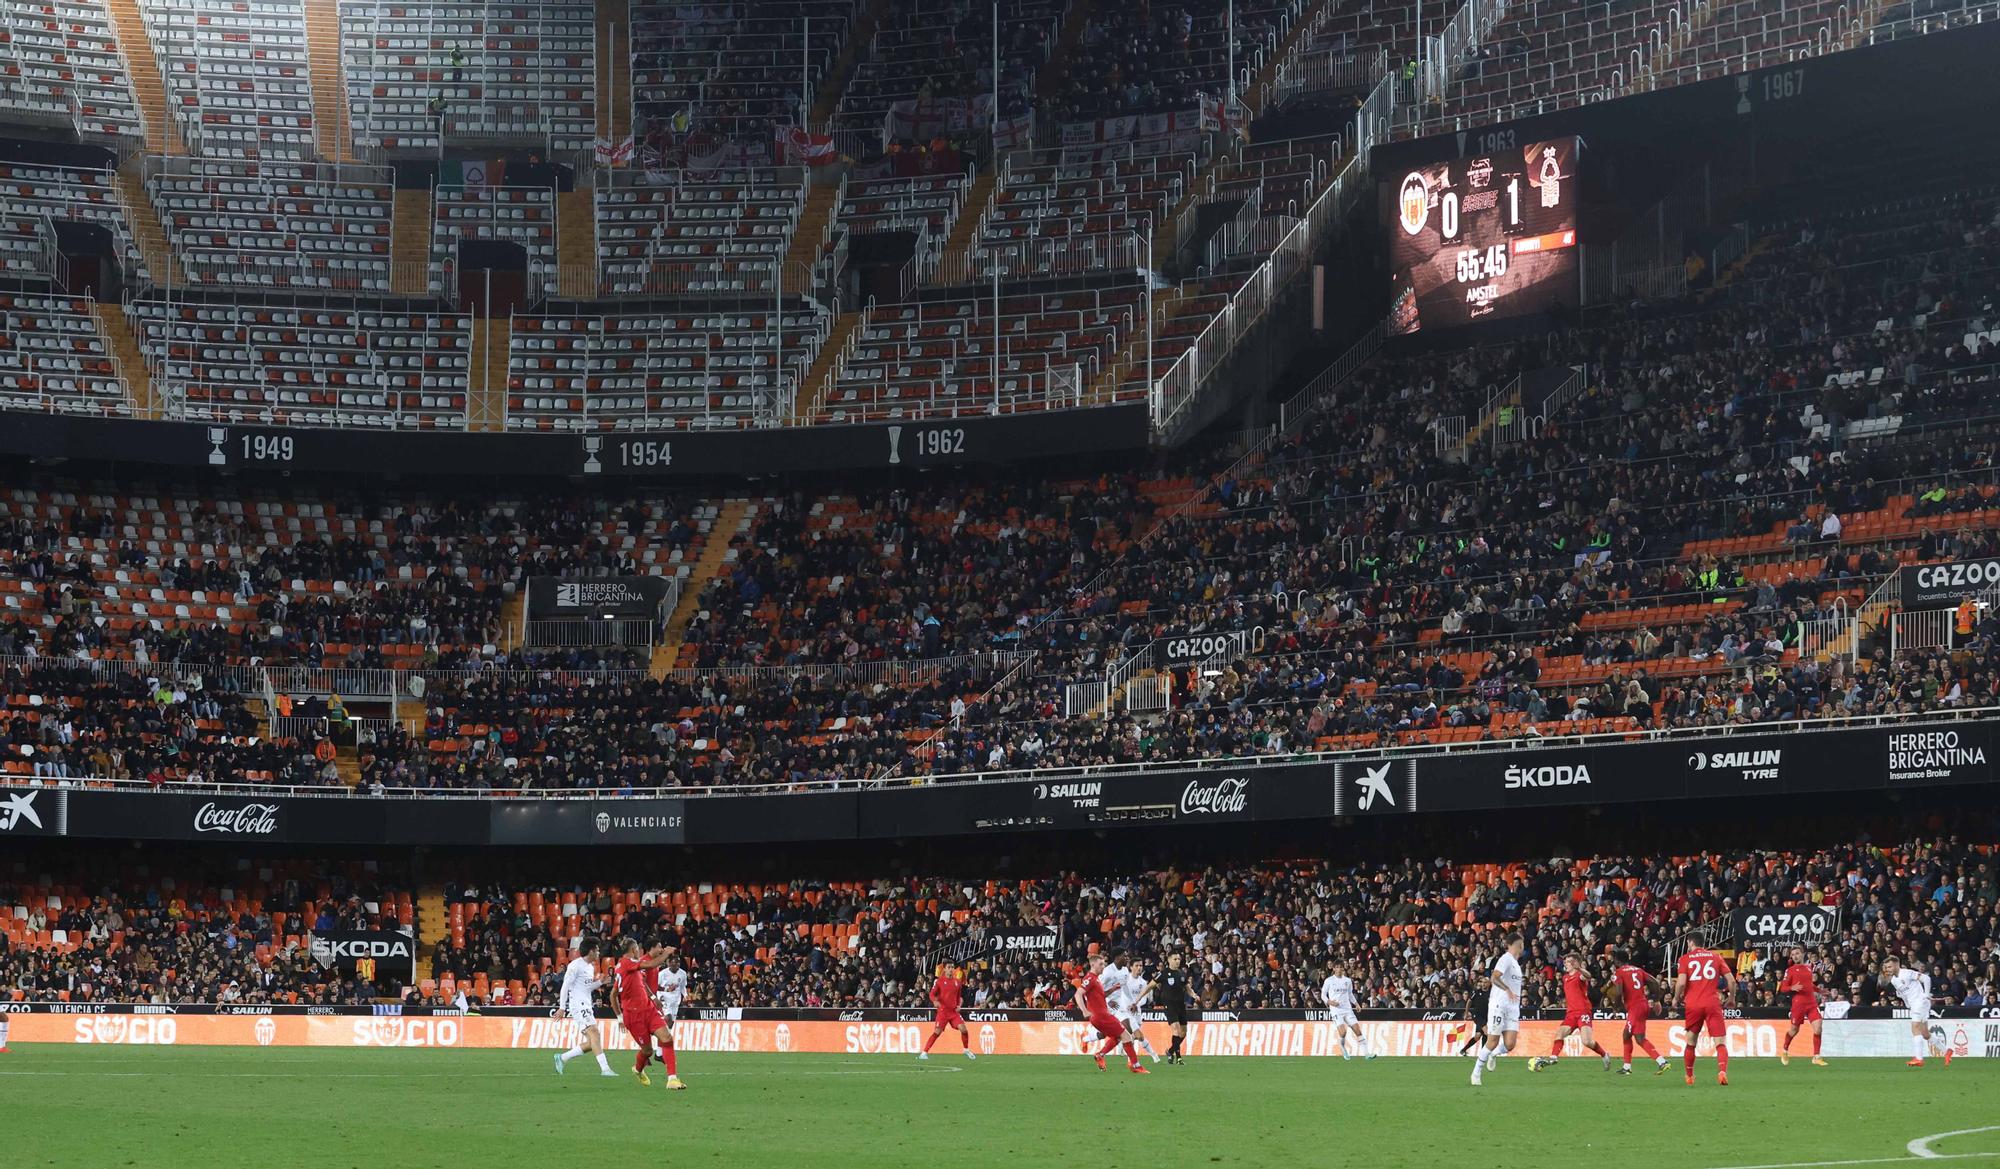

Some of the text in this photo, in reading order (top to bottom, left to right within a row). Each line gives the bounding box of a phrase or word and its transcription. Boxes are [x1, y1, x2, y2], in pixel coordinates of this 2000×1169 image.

[1762, 69, 1804, 101] 1967
[1478, 129, 1515, 154] 1963
[1507, 178, 1518, 225] 1
[1442, 192, 1458, 239] 0
[1456, 243, 1507, 283] 55:45
[1465, 285, 1499, 302] AMSTEL
[241, 434, 294, 461] 1949
[916, 428, 965, 456] 1962
[620, 442, 672, 466] 1954
[1917, 561, 2000, 589] CAZOO
[581, 583, 627, 592] HERRERO
[581, 592, 644, 601] BRIGANTINA
[1167, 636, 1227, 658] CAZOO
[1889, 731, 1958, 752] HERRERO
[1711, 750, 1781, 768] SAILUN
[1889, 747, 1986, 769] BRIGANTINA
[1504, 764, 1592, 788] ŠKODA
[1742, 768, 1779, 780] TYRE
[1889, 769, 1951, 780] Insurance Broker
[1050, 782, 1102, 798] SAILUN
[1180, 777, 1250, 814] Coca-Cola
[1072, 798, 1100, 808] TYRE
[194, 802, 280, 834] Coca-Cola
[1745, 913, 1826, 936] CAZOO
[312, 937, 410, 958] ŠKODA
[1005, 935, 1056, 950] SAILUN
[1631, 972, 1641, 990] 5
[1688, 960, 1717, 981] 26
[49, 1004, 106, 1014] VALENCIA CF
[232, 1006, 273, 1015] SAILUN
[307, 1006, 335, 1014] HERRERO
[699, 1009, 727, 1020] VALENCIA
[968, 1011, 1009, 1022] ŠKODA
[1044, 1010, 1067, 1018] HERRERO
[1141, 1011, 1168, 1021] AILUN
[1202, 1011, 1230, 1021] PUMA
[511, 1018, 526, 1049] Y
[671, 1021, 741, 1051] ENTAJAS
[1186, 1024, 1200, 1056] Y
[1201, 1023, 1304, 1056] DISFRUTA
